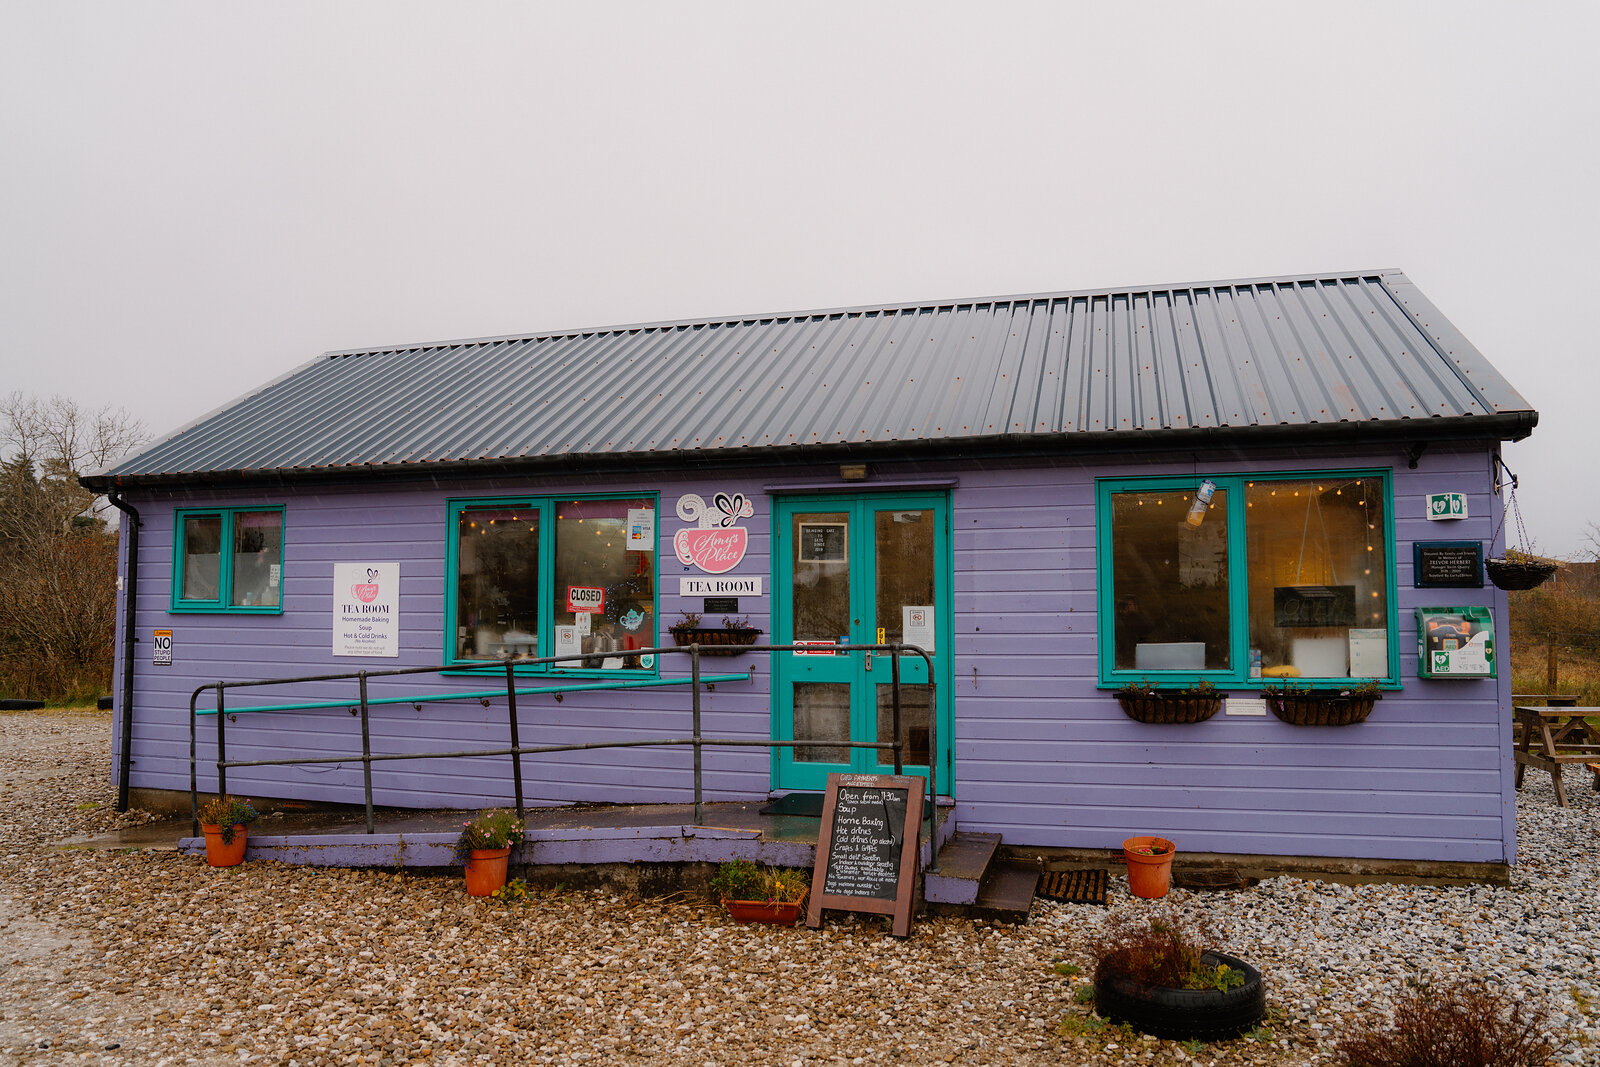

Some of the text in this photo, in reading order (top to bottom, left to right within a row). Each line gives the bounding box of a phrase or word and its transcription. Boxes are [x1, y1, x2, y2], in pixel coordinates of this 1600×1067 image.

[694, 531, 738, 552] Amy's
[696, 547, 738, 566] Place
[686, 582, 754, 592] TEA ROOM
[571, 589, 601, 602] CLOSED
[342, 604, 389, 614] TEA ROOM
[154, 637, 170, 649] NO
[840, 788, 859, 802] Open
[863, 791, 879, 801] from
[838, 802, 856, 815] Soup
[838, 815, 884, 831] Home Baking
[836, 826, 871, 834] Hot drinks
[837, 835, 849, 843] Cold
[851, 835, 868, 843] drinks
[870, 836, 878, 846] (no
[832, 852, 847, 860] Small
